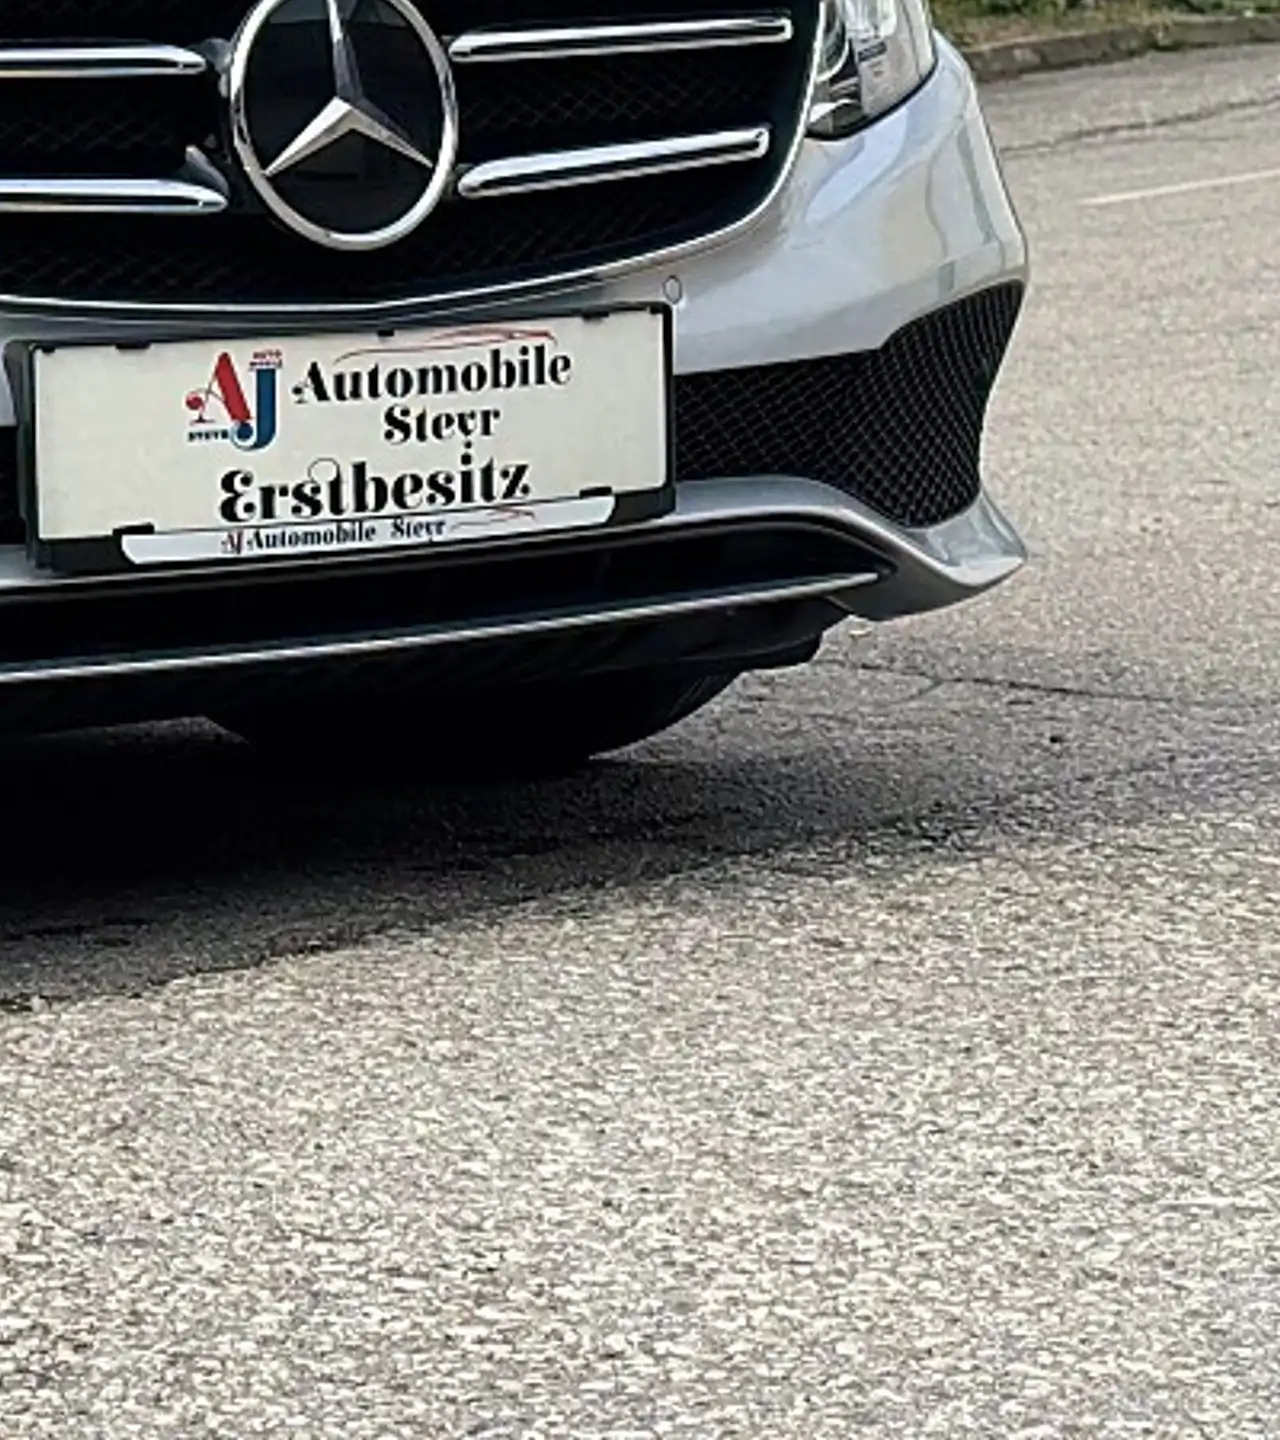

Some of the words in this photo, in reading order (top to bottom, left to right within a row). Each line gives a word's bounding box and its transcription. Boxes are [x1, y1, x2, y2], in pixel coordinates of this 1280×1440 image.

[292, 345, 572, 404] Automobile
[384, 403, 500, 449] Steyr
[219, 452, 531, 523] Erstbesitz
[246, 520, 376, 552] Automobile
[389, 515, 446, 543] Steyr
